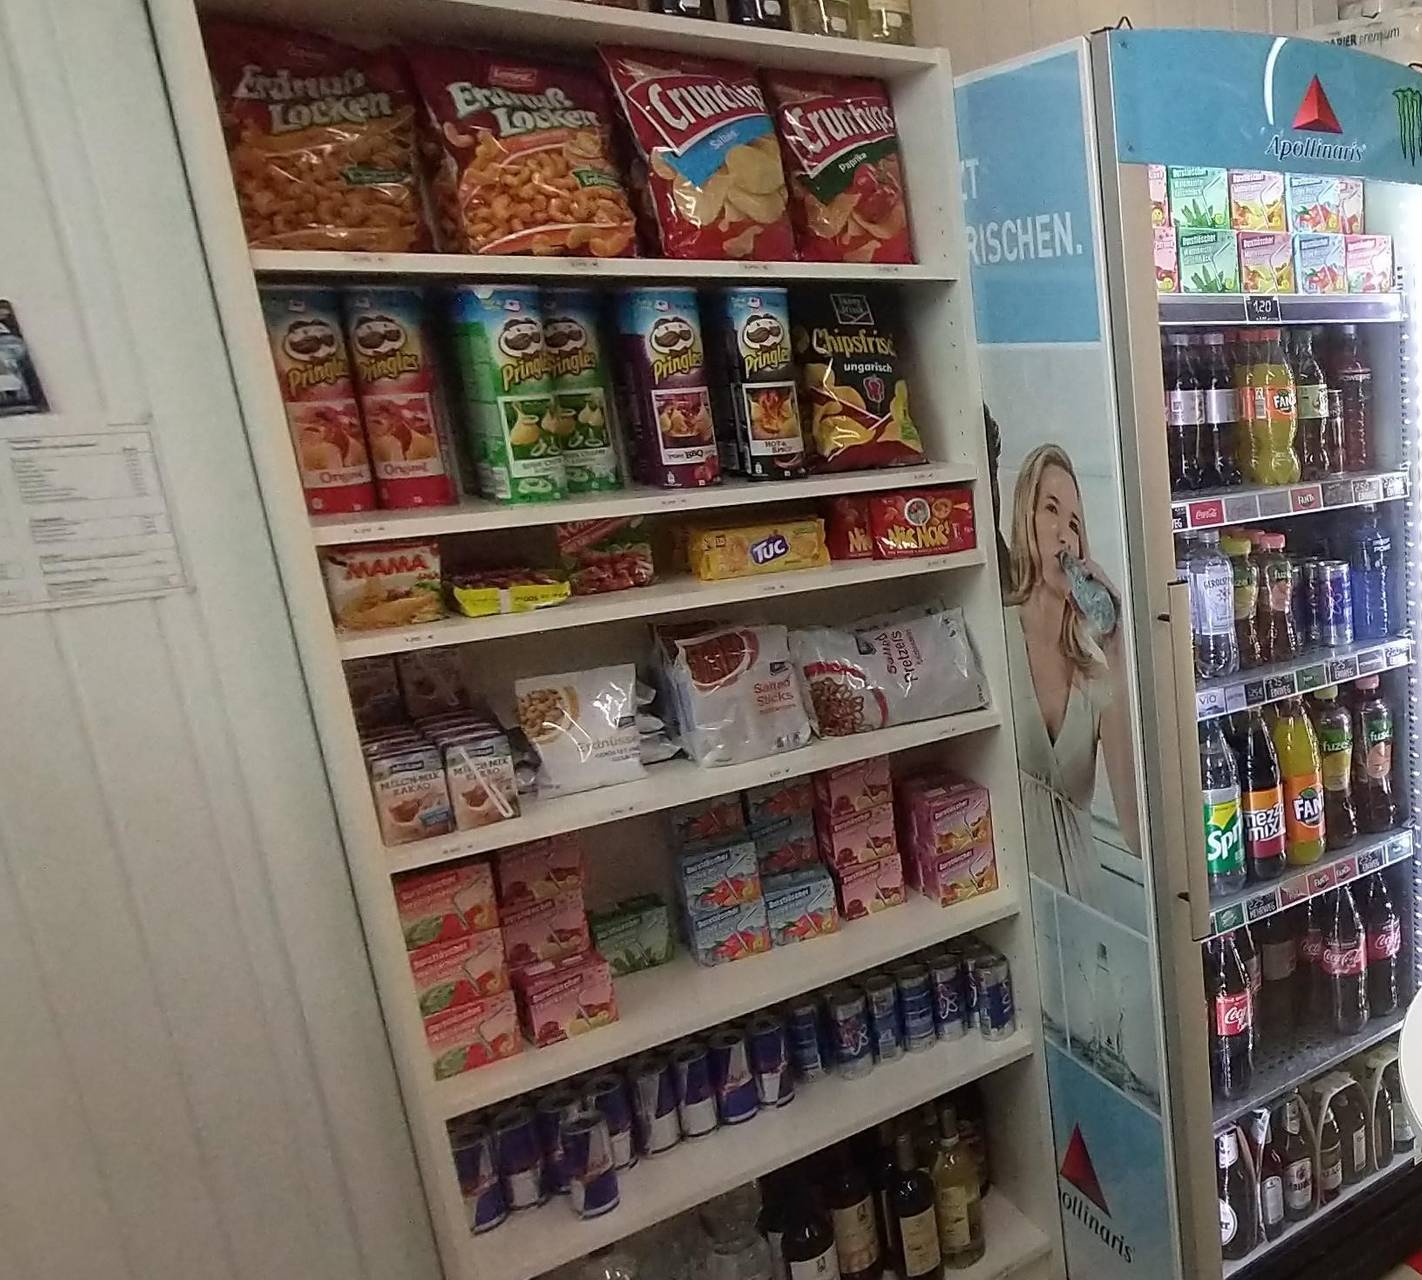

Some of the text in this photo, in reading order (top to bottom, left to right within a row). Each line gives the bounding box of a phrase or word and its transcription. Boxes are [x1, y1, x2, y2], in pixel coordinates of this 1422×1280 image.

[648, 82, 765, 131] Crunchip
[490, 107, 601, 137] Locken
[790, 103, 896, 154] Crunchips
[837, 151, 868, 174] Paprika
[1264, 135, 1364, 164] Apollinaris
[843, 360, 893, 374] ungarisch
[752, 538, 787, 562] TUC
[345, 553, 429, 581] MAMA
[755, 690, 794, 706] Sticks
[1293, 798, 1324, 821] FAN
[1207, 820, 1242, 862] Spri
[1058, 1189, 1135, 1264] ollinaris
